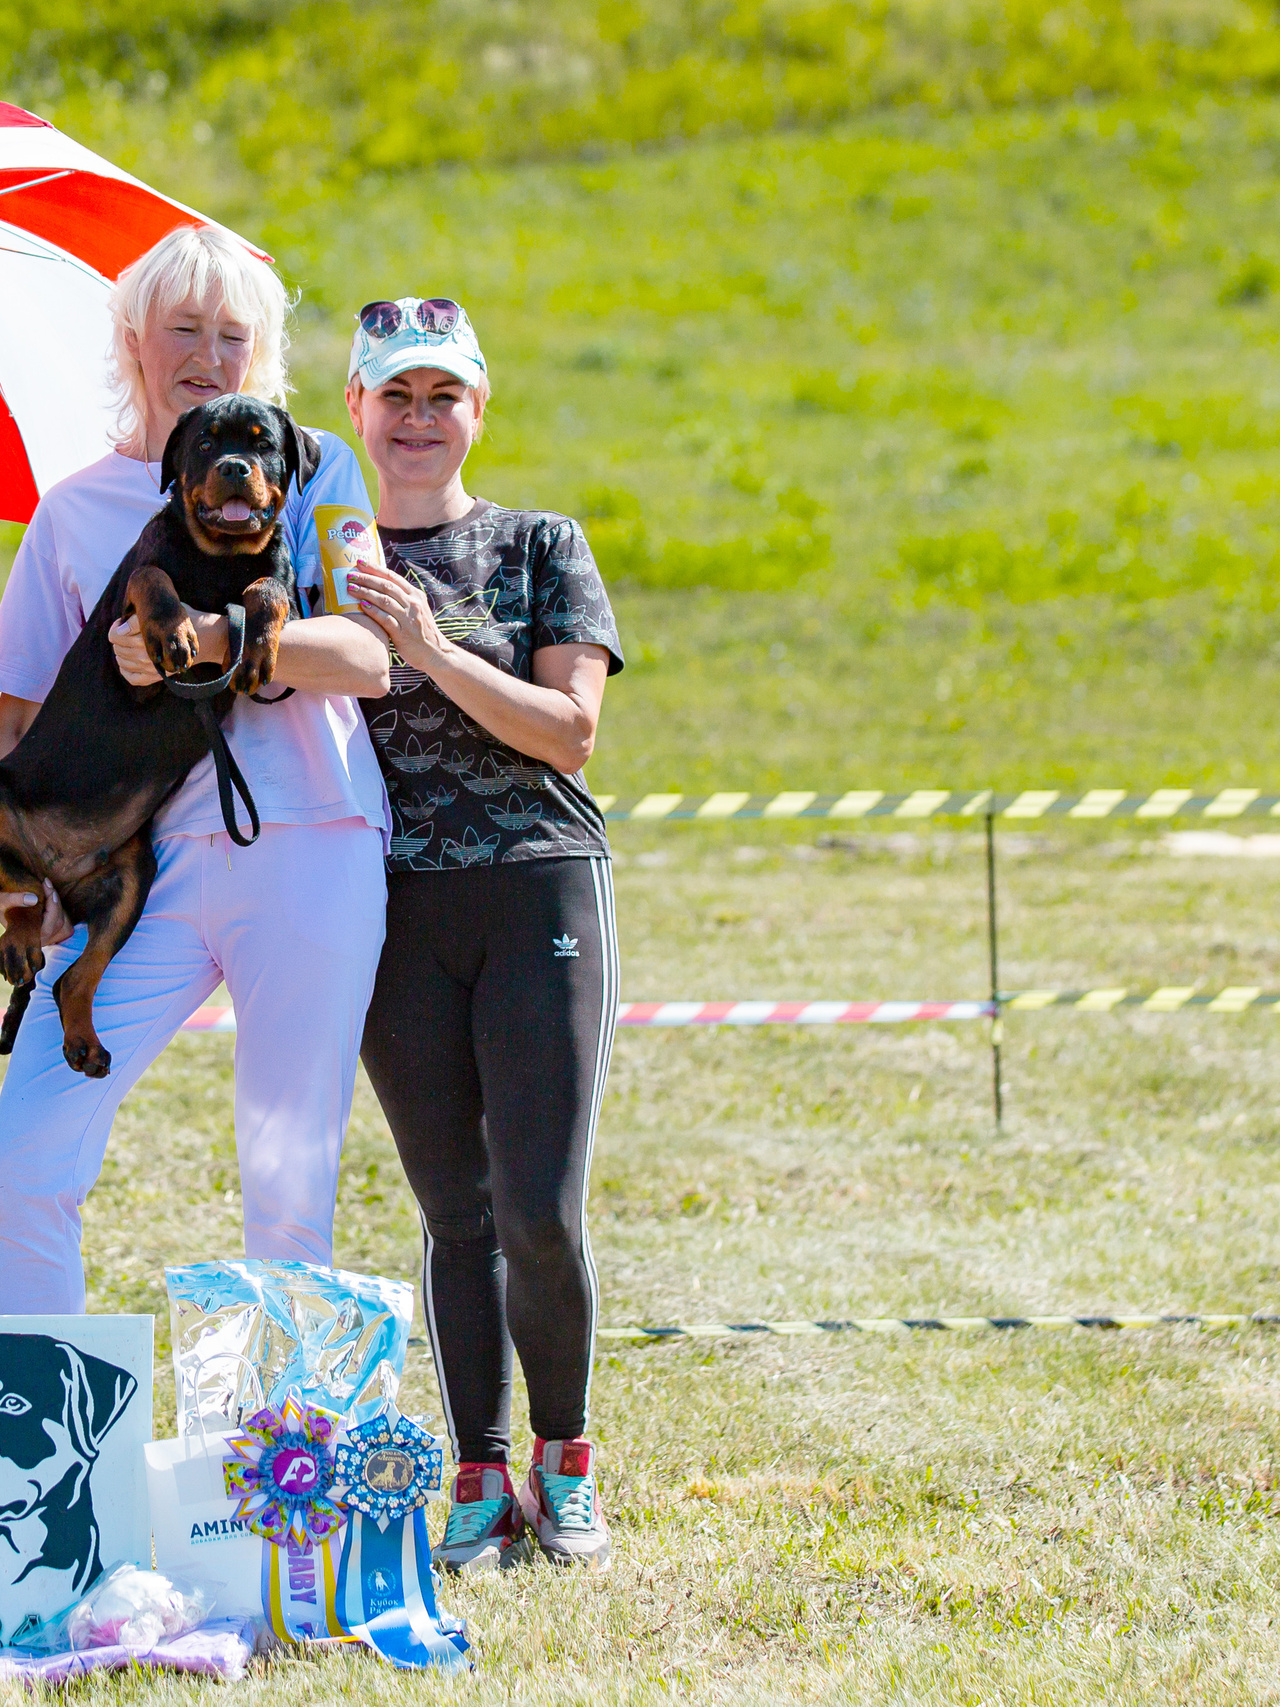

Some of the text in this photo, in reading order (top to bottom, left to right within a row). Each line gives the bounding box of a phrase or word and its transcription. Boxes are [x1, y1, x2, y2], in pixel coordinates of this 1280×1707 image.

[327, 528, 372, 541] Pedigr
[553, 949, 580, 958] adidas
[190, 1518, 249, 1539] AMIN
[287, 1539, 317, 1605] BABY
[370, 1597, 399, 1608] Кубок
